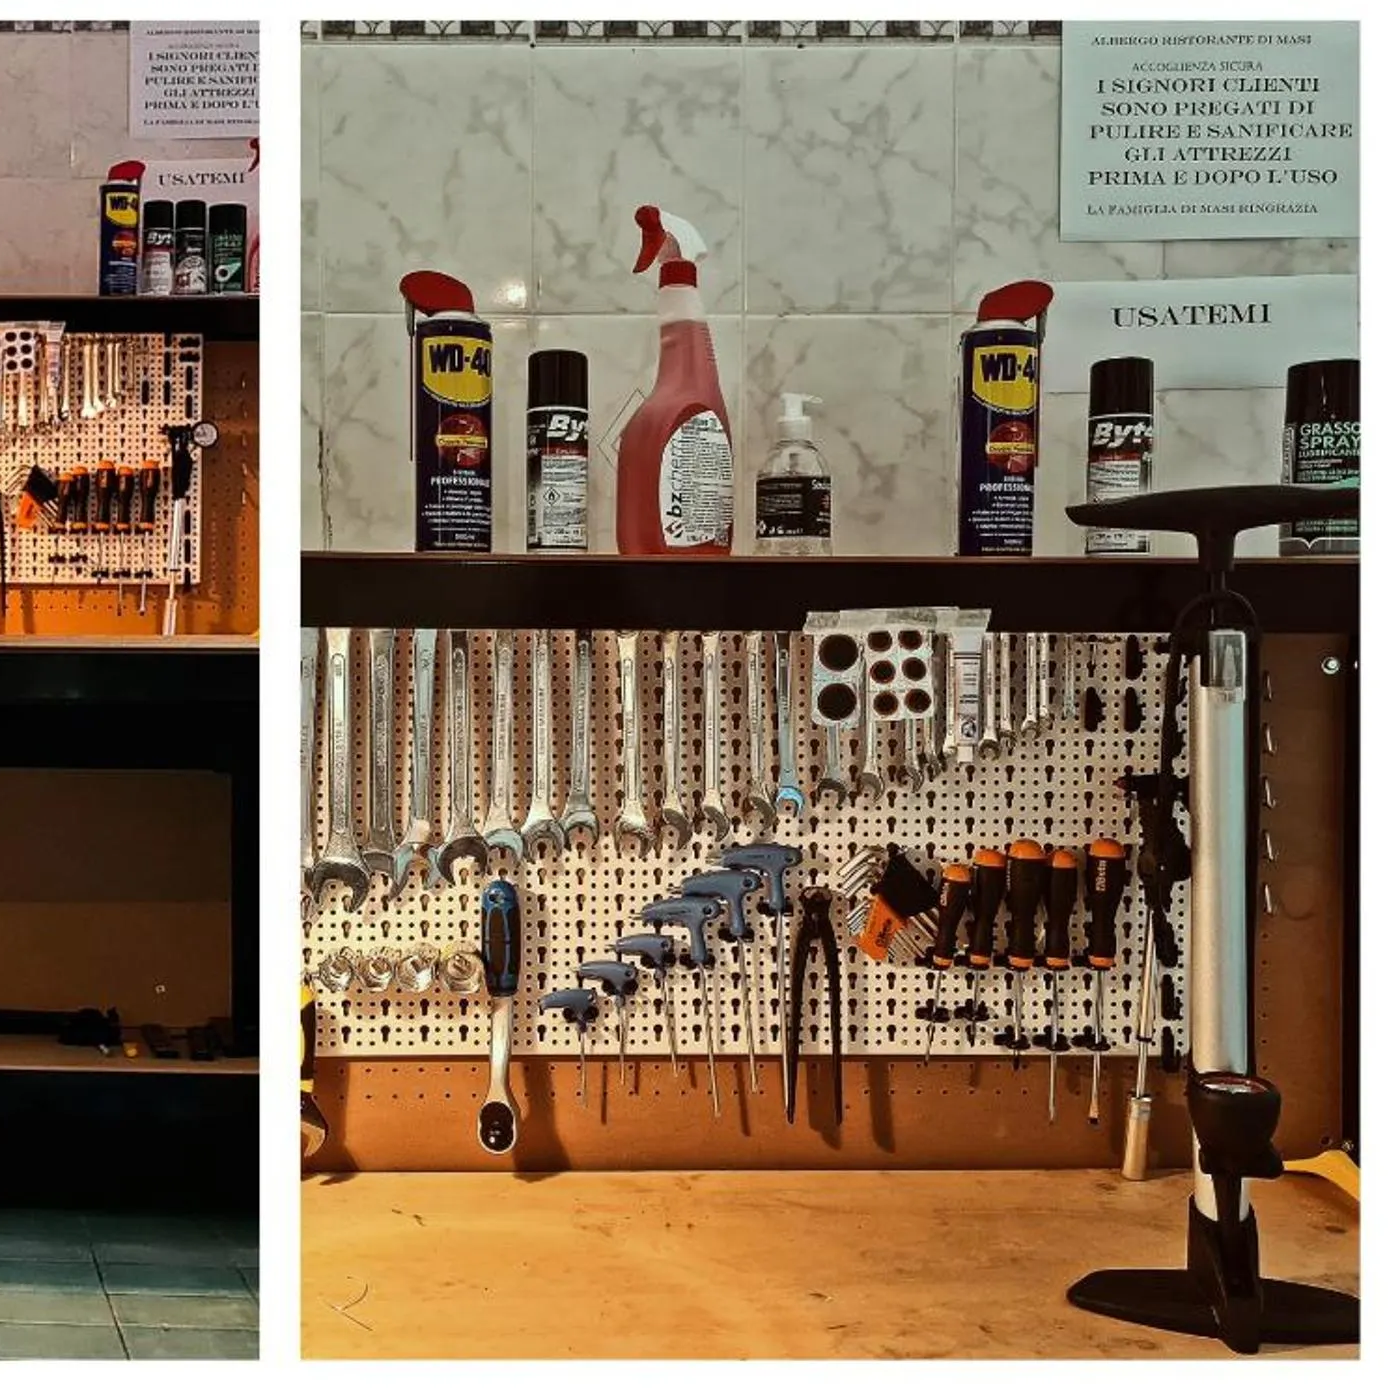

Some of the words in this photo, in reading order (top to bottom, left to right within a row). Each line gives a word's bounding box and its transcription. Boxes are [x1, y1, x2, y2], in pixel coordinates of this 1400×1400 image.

[1091, 36, 1158, 46] ALBERGO
[1161, 35, 1254, 46] RISTORANTE
[1258, 35, 1273, 45] DI
[1276, 35, 1312, 45] MASI
[1132, 62, 1216, 72] ACCOGLIENZA
[1220, 61, 1263, 72] SICURA
[1096, 79, 1105, 93] I
[1112, 79, 1215, 93] SIGNORI
[1223, 78, 1321, 93] CLIENTI
[1101, 102, 1167, 116] SONO
[1174, 101, 1281, 116] PREGATI
[1289, 101, 1315, 115] DI
[1089, 125, 1180, 140] PULIRE
[1187, 125, 1201, 139] E
[1207, 124, 1353, 138] SANIFICARE
[1125, 148, 1164, 161] GLI
[1172, 147, 1292, 162] ATTREZZI
[158, 173, 245, 186] USATEMI
[1088, 171, 1166, 185] PRIMA
[1174, 171, 1187, 185] E
[1194, 170, 1261, 185] DOPO
[1268, 169, 1338, 185] L'USO
[1086, 205, 1104, 215] LA
[1108, 205, 1176, 215] FAMIGLIA
[1201, 204, 1235, 214] MASI
[1239, 204, 1318, 214] RINGRAZIA
[1111, 303, 1272, 327] USATEMI
[1300, 421, 1360, 436] GRASSO
